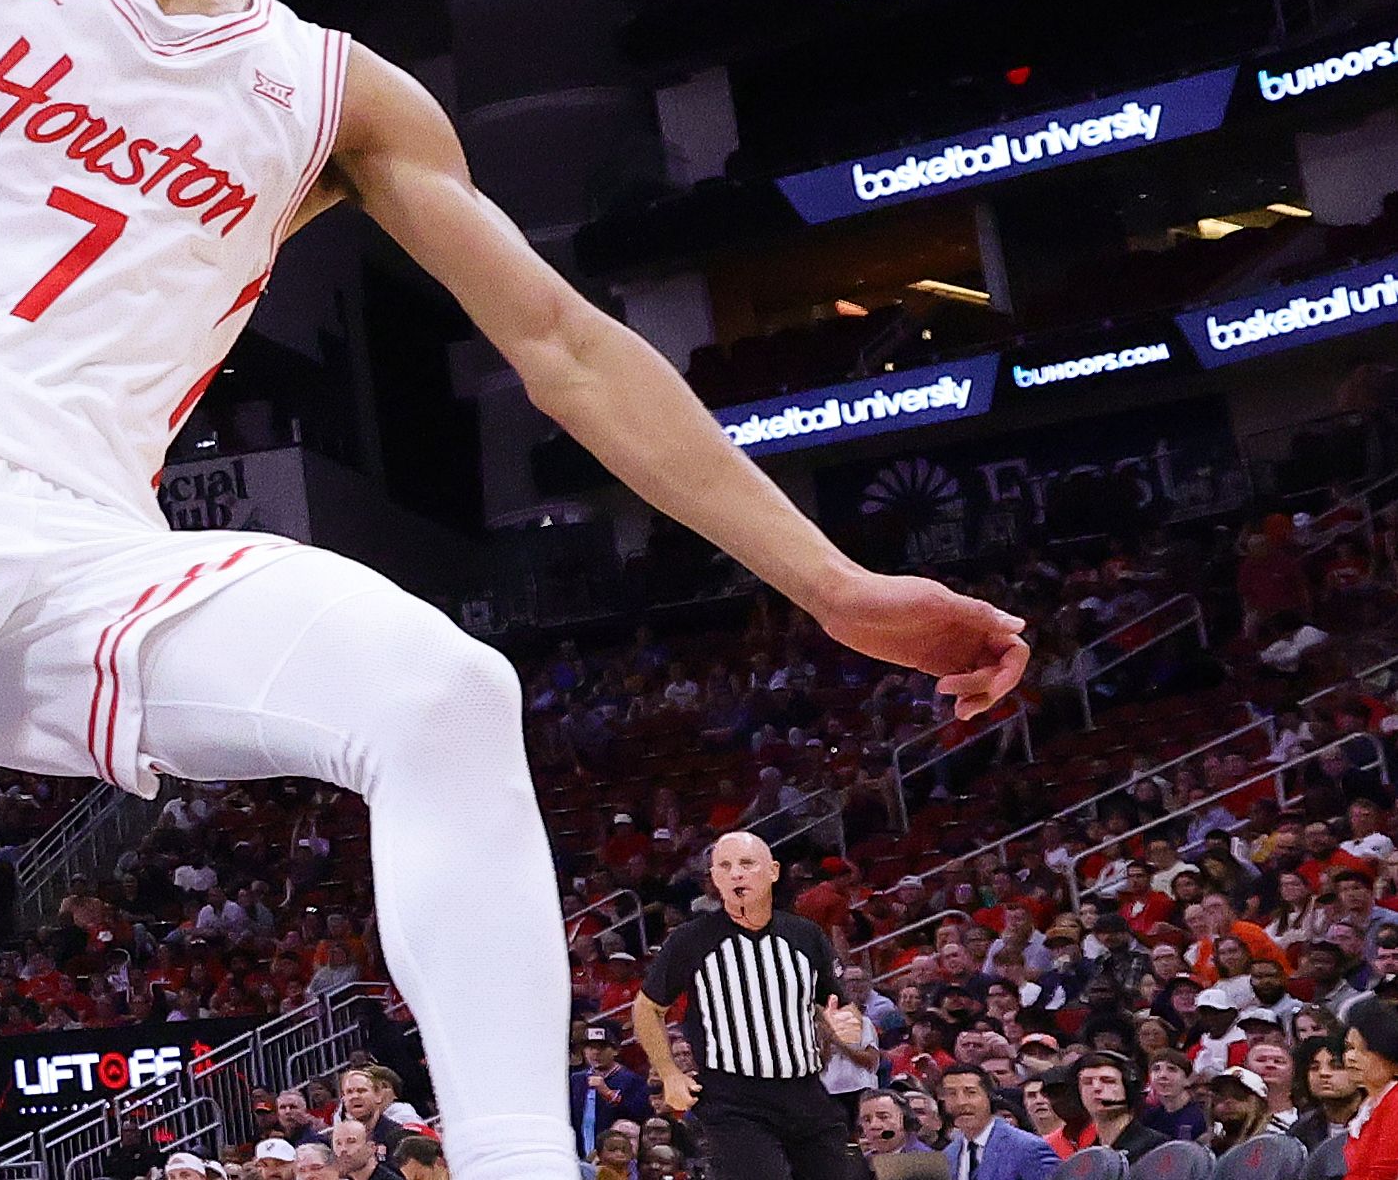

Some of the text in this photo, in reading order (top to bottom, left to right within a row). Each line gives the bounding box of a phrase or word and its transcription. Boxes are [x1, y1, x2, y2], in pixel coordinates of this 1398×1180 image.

[1258, 38, 1398, 101] bUHOOPS.
[852, 102, 1163, 202] basketball university
[9, 186, 129, 323] 7
[1207, 286, 1352, 351] basketball
[721, 375, 973, 446] asketball university
[165, 459, 249, 503] cial
